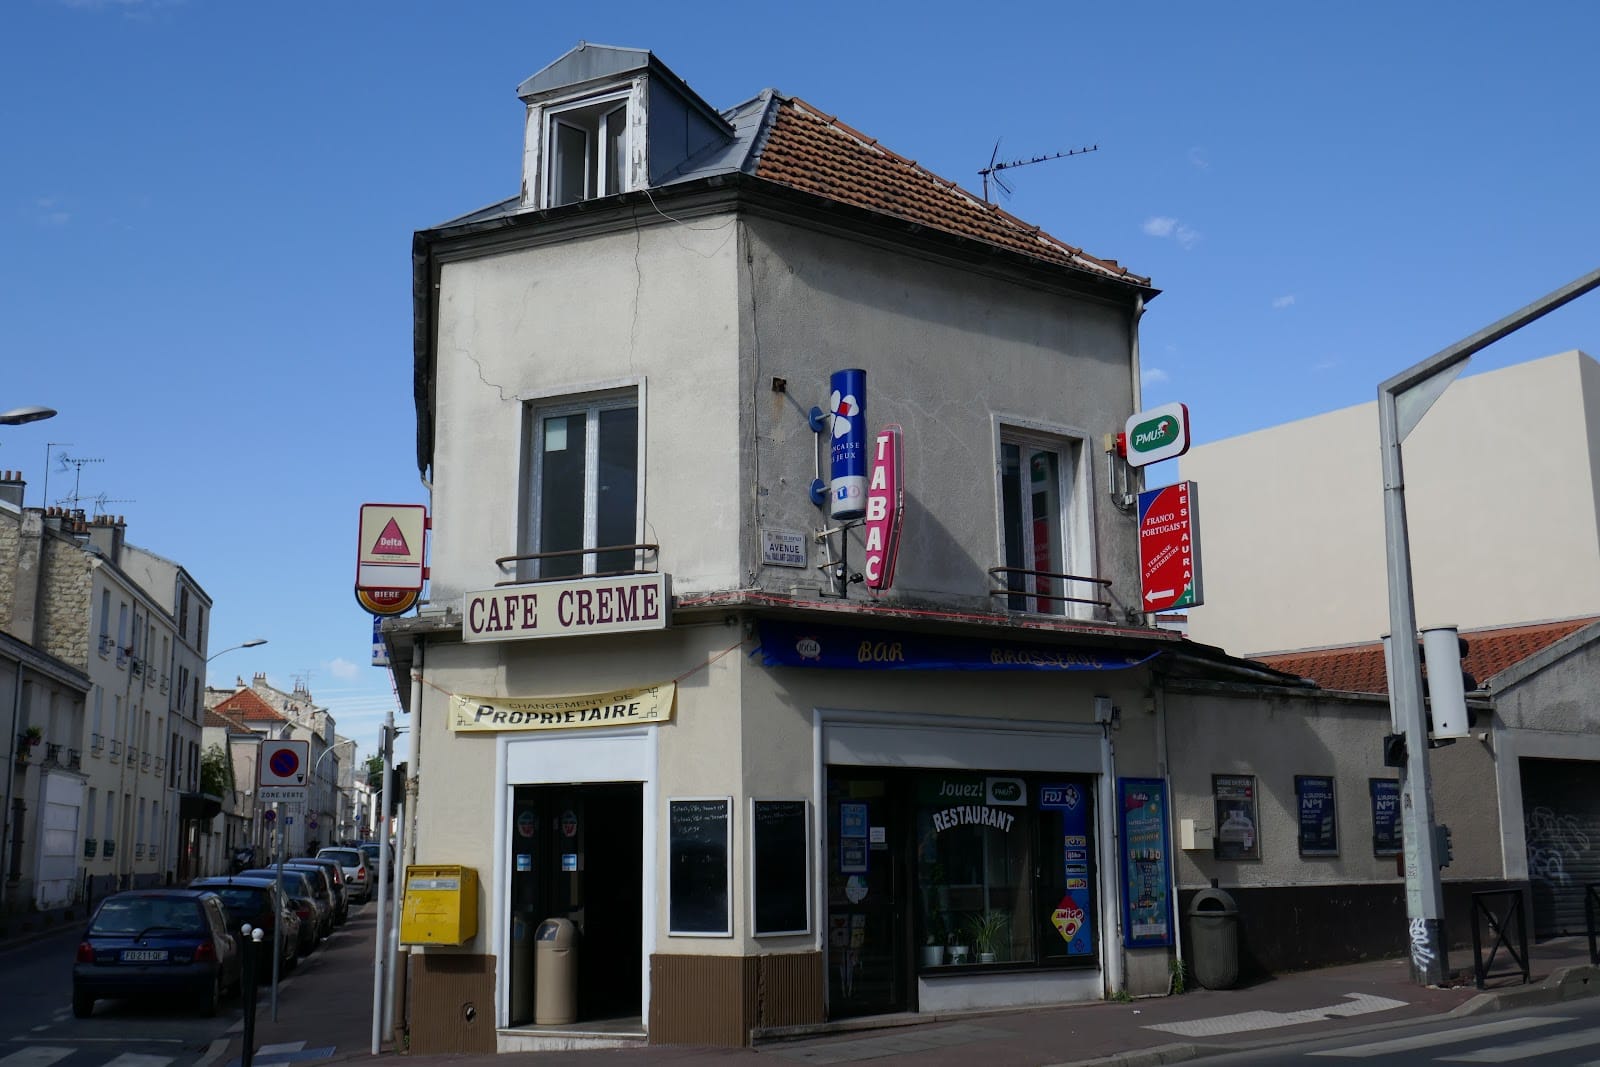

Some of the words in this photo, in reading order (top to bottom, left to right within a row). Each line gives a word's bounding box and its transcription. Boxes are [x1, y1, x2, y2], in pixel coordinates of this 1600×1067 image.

[1136, 430, 1158, 446] PMU
[836, 453, 856, 462] JEUX
[866, 436, 889, 581] TABAC
[1146, 513, 1175, 526] FRANCO
[1142, 522, 1180, 538] PORTUGAIS
[380, 537, 402, 546] Delta
[769, 543, 800, 554] AVENUE
[1178, 484, 1192, 604] RESTAURANT
[1147, 544, 1172, 568] TERRASSE
[470, 593, 538, 634] CAFE
[558, 584, 659, 627] CREME
[509, 698, 605, 710] CHANGEMENT
[613, 693, 634, 702] DE
[474, 702, 641, 724] PROPRIETAIRE
[939, 780, 984, 797] Jouez!
[1044, 791, 1062, 803] FDJ
[1377, 800, 1395, 810] N°1
[932, 805, 1015, 832] RESTAURANT
